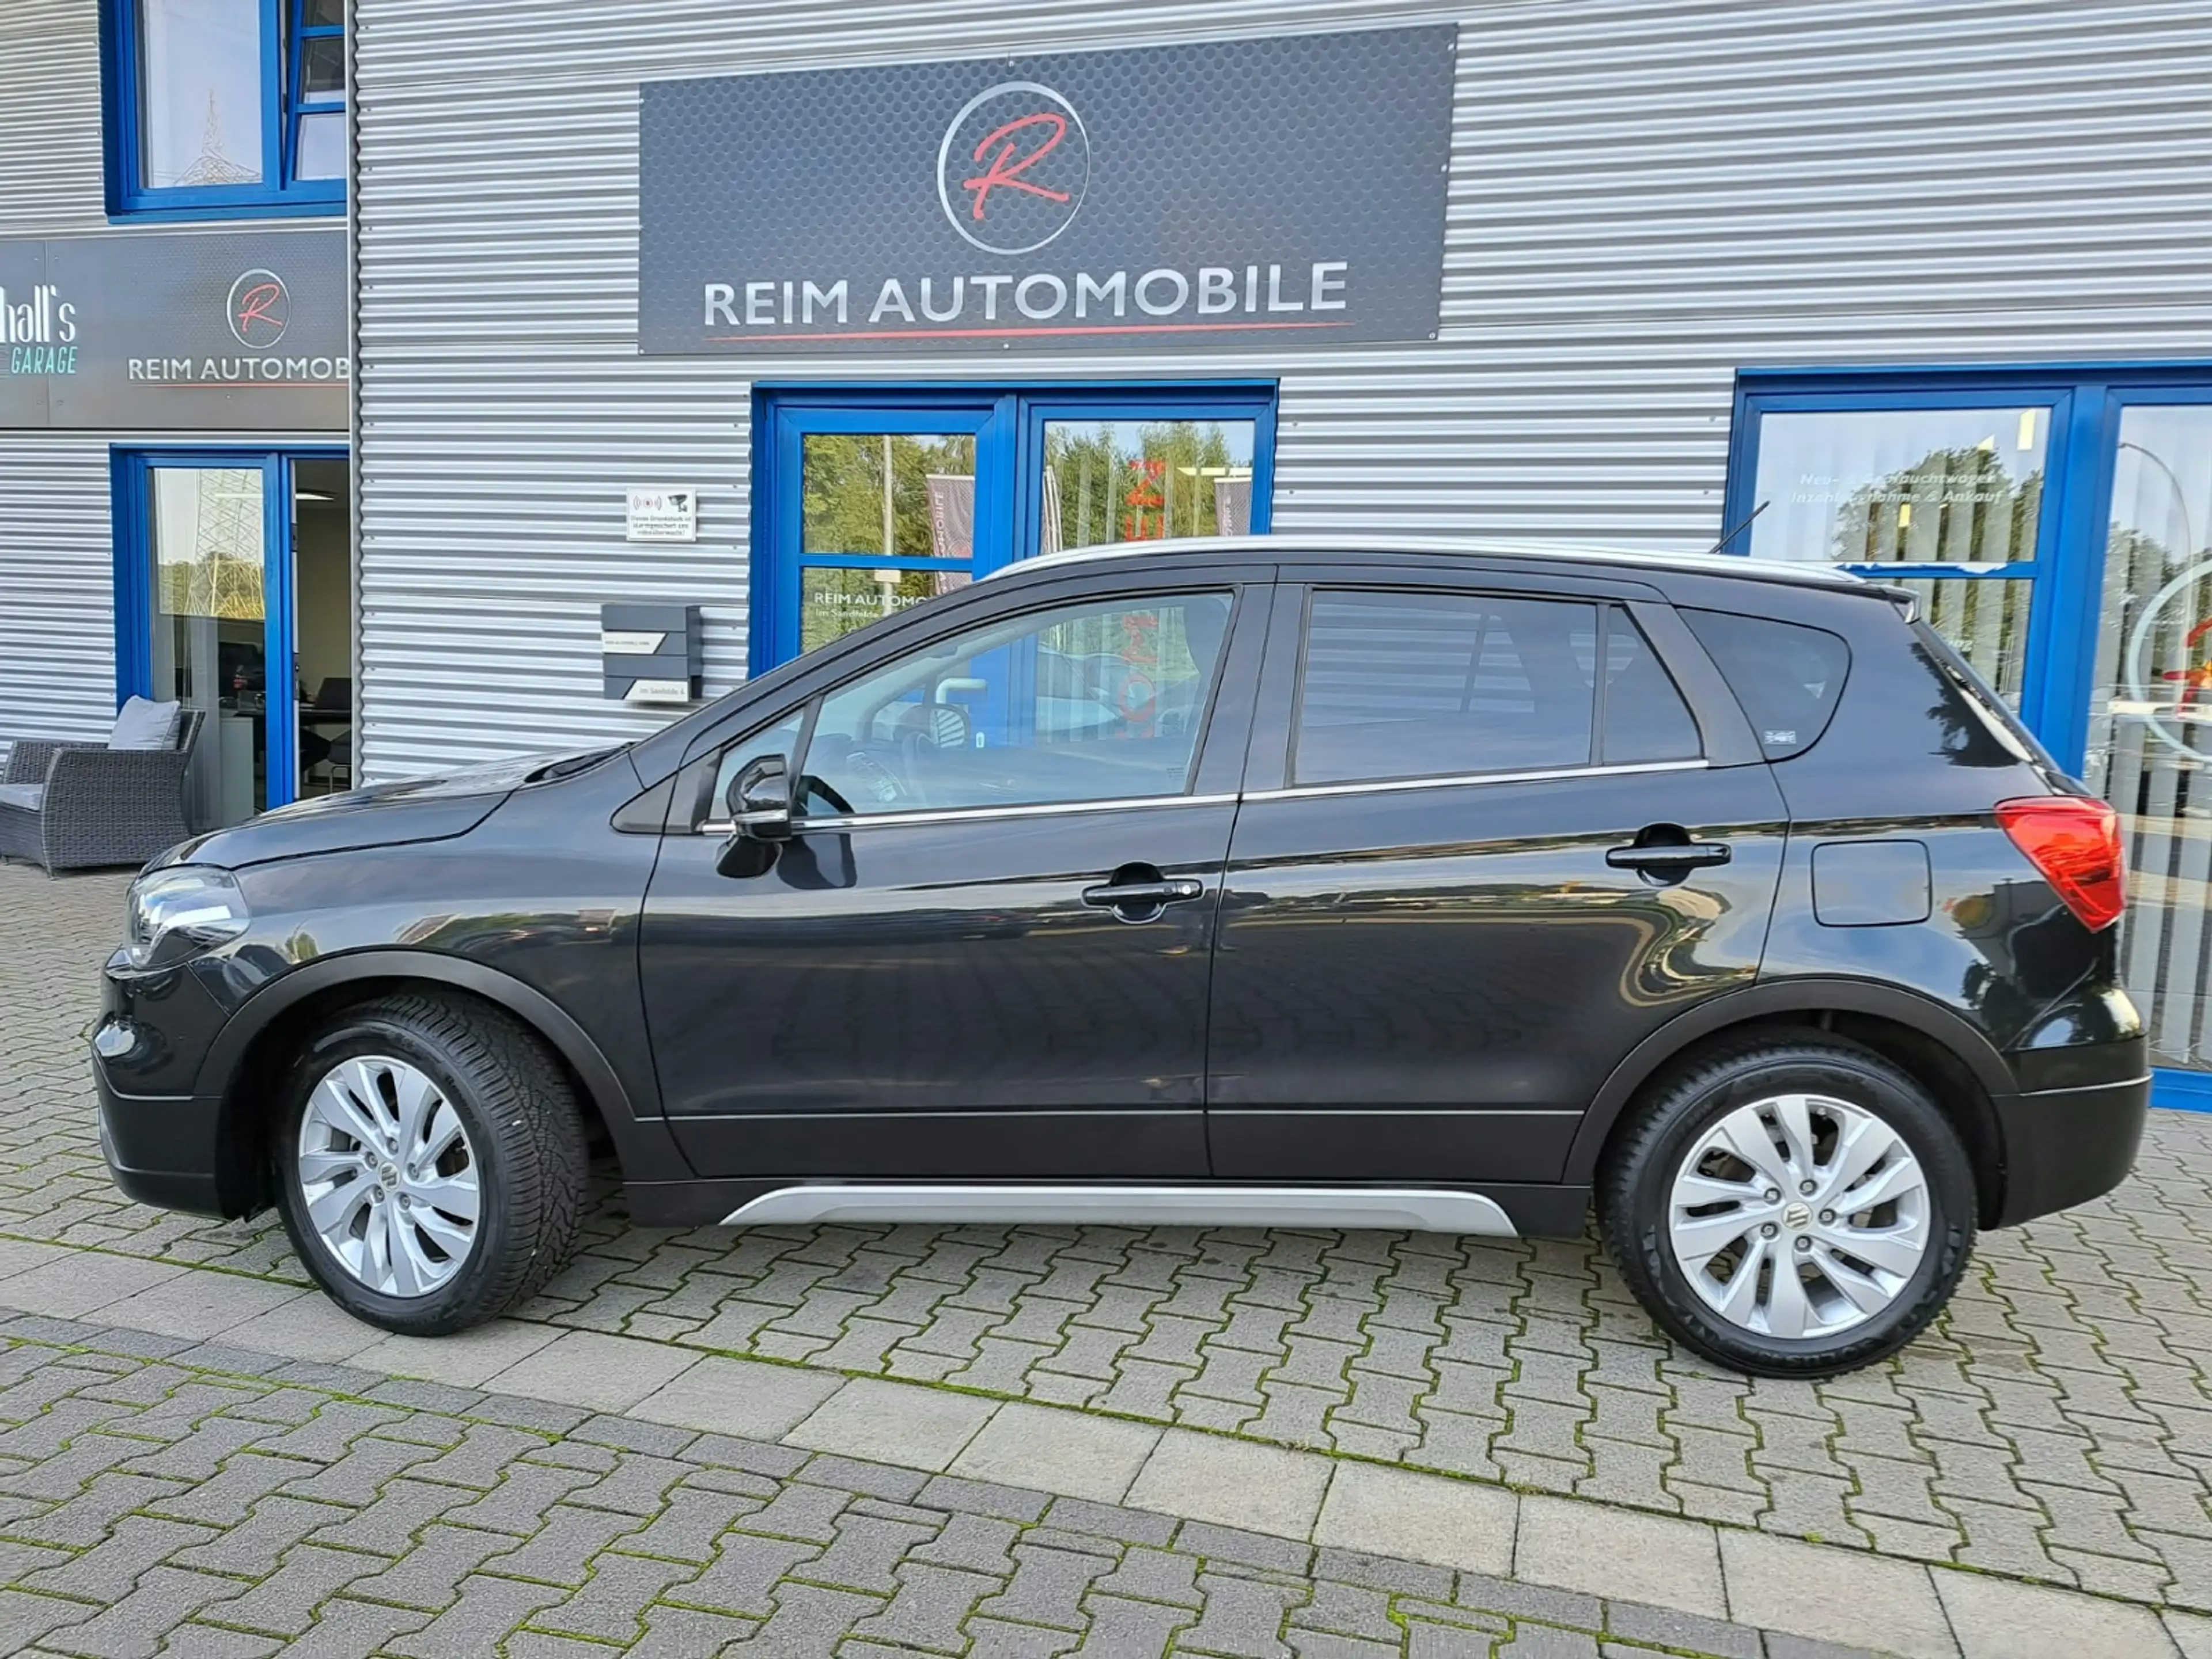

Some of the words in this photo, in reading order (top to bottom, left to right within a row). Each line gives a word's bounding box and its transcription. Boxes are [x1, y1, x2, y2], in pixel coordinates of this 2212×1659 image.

[963, 113, 1070, 220] R
[703, 279, 849, 327] REIM
[869, 260, 1349, 323] AUTOMOBILE
[10, 346, 78, 374] GARAGE
[128, 358, 192, 381] REIM
[814, 592, 851, 604] REIM
